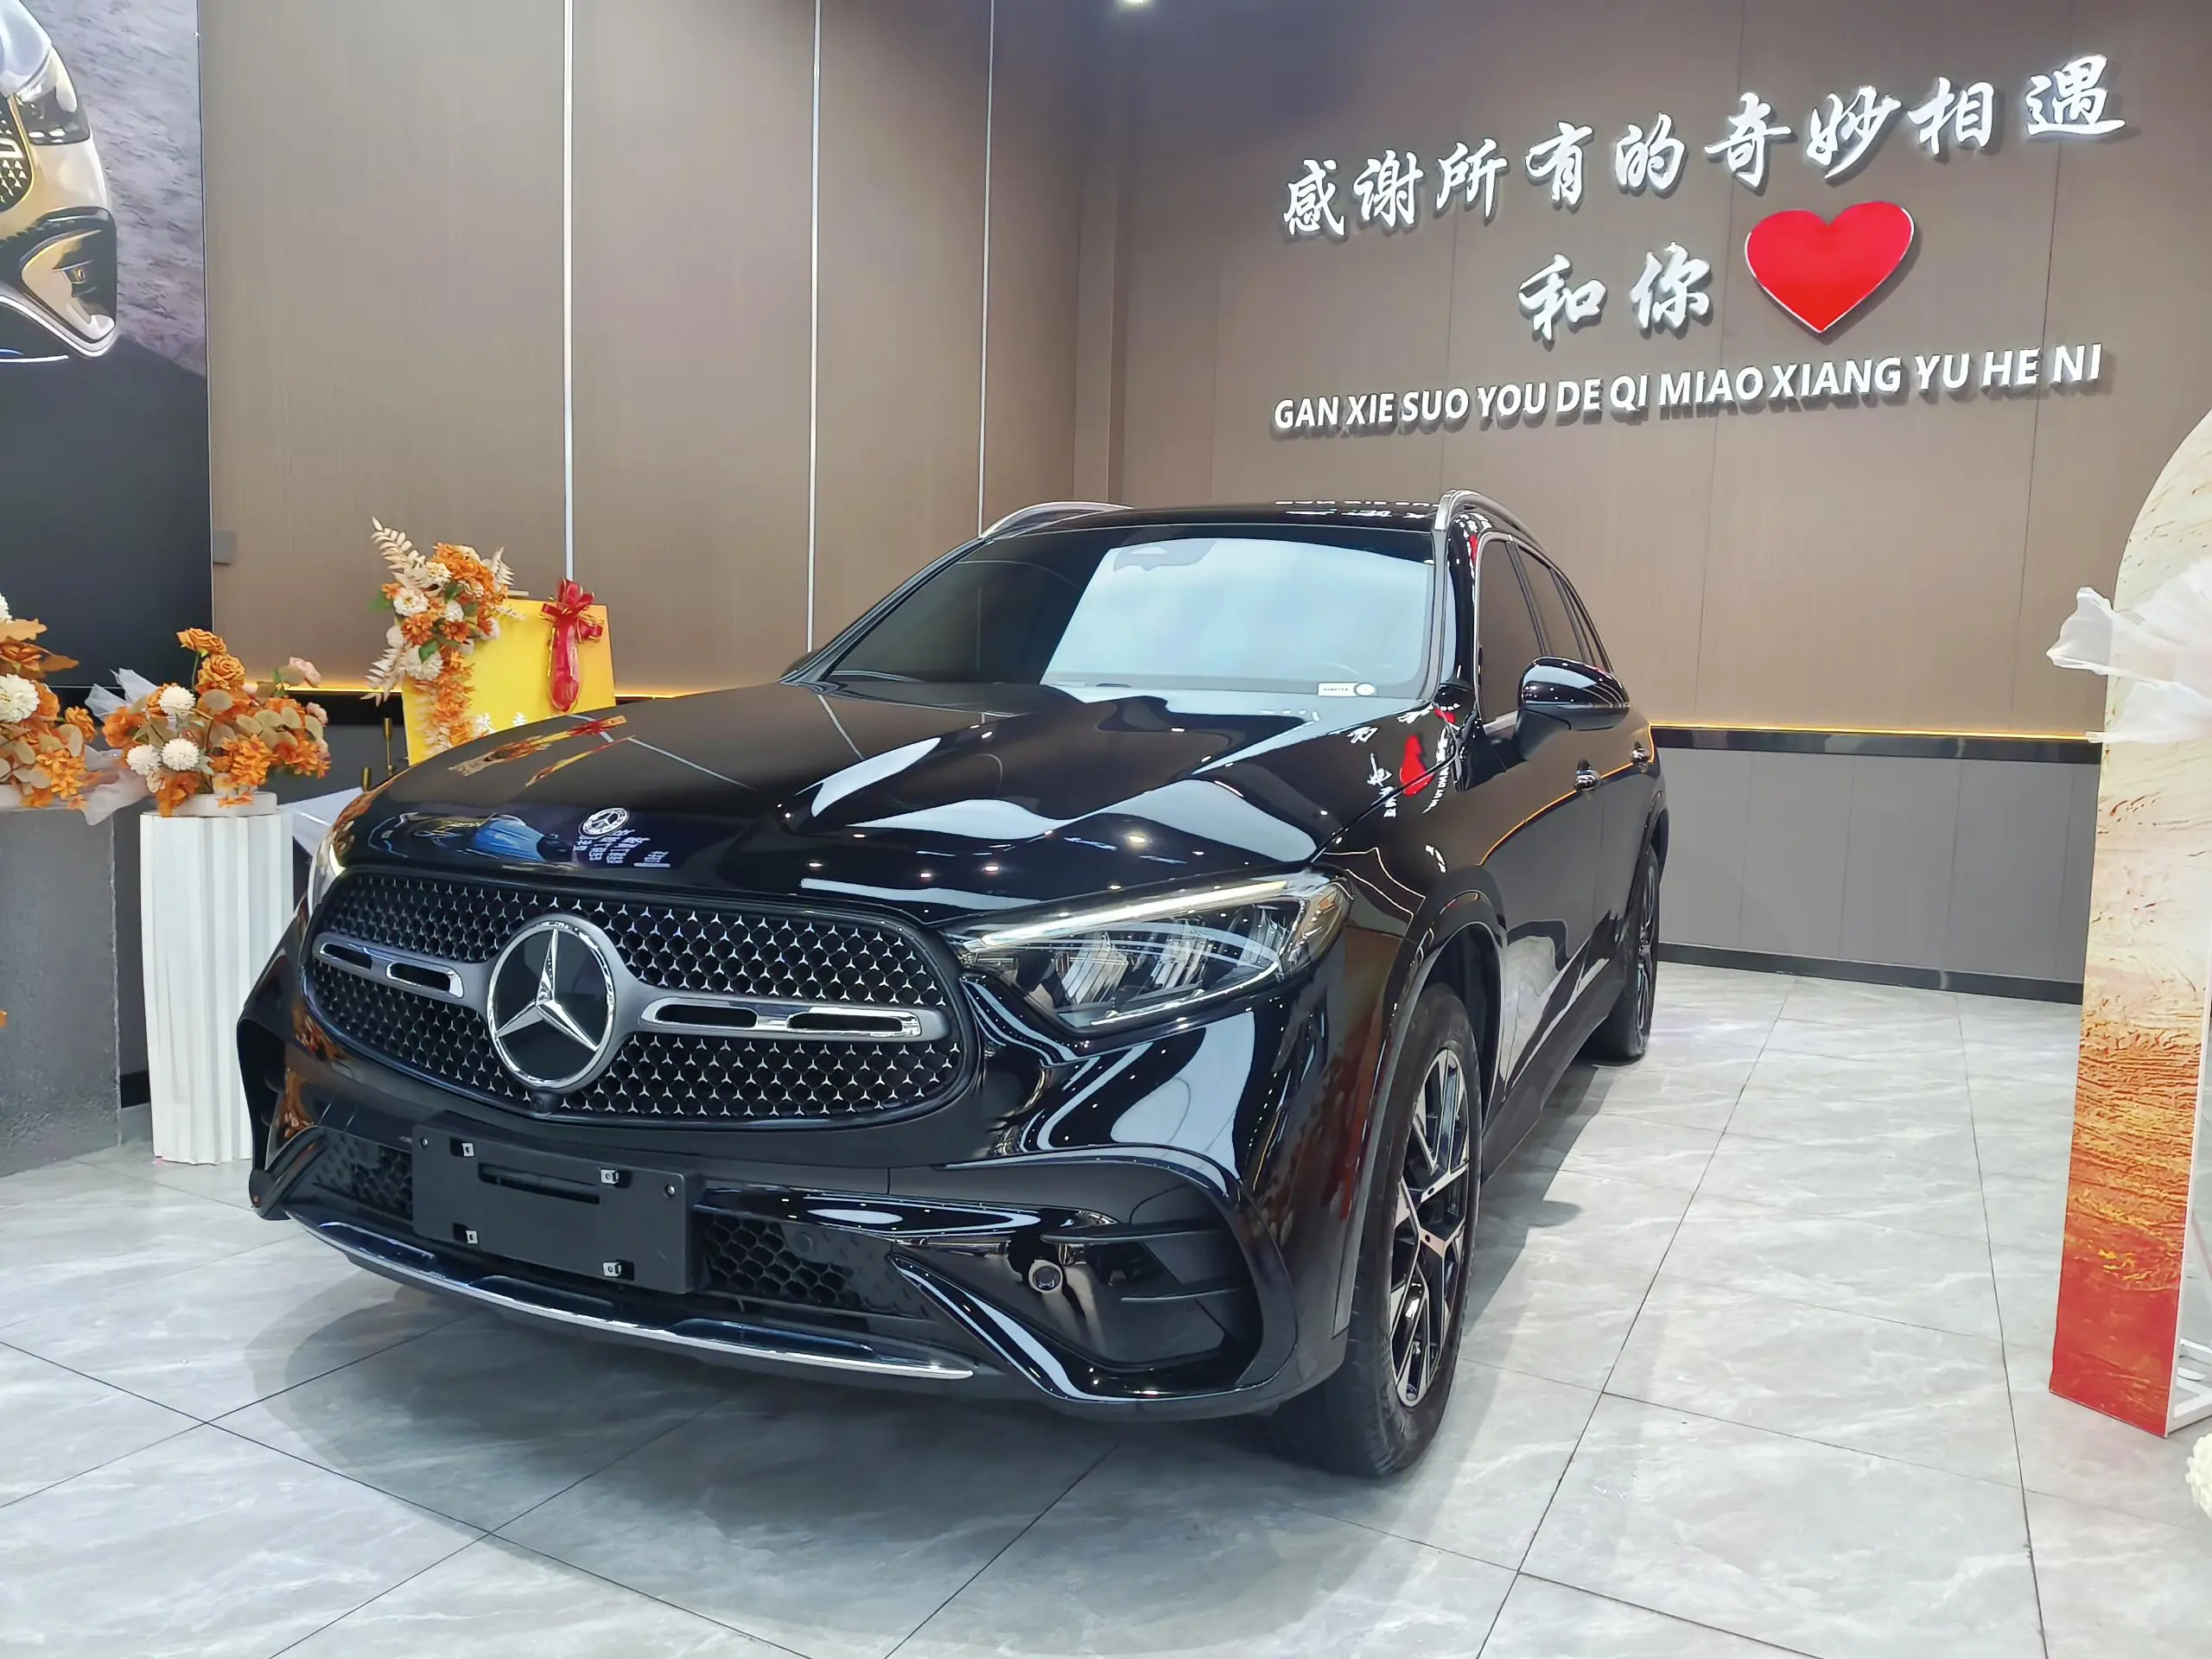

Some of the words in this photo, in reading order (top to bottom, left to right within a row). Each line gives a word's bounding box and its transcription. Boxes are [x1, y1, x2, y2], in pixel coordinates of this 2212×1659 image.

[1283, 54, 2126, 237] 感谢所有的奇妙相遇
[1518, 241, 1711, 340] 和你
[1274, 397, 1339, 429] GAN
[1344, 393, 1395, 425] XIE
[1400, 388, 1469, 423] SUO
[1477, 382, 1547, 417] YOU
[1555, 378, 1602, 413] DE
[1610, 374, 1649, 411] QI
[1658, 366, 1764, 406] MIAO
[1769, 357, 1902, 399] XIANG
[1915, 352, 1971, 390] YU
[1981, 347, 2041, 386] HE
[2050, 343, 2102, 383] NI
